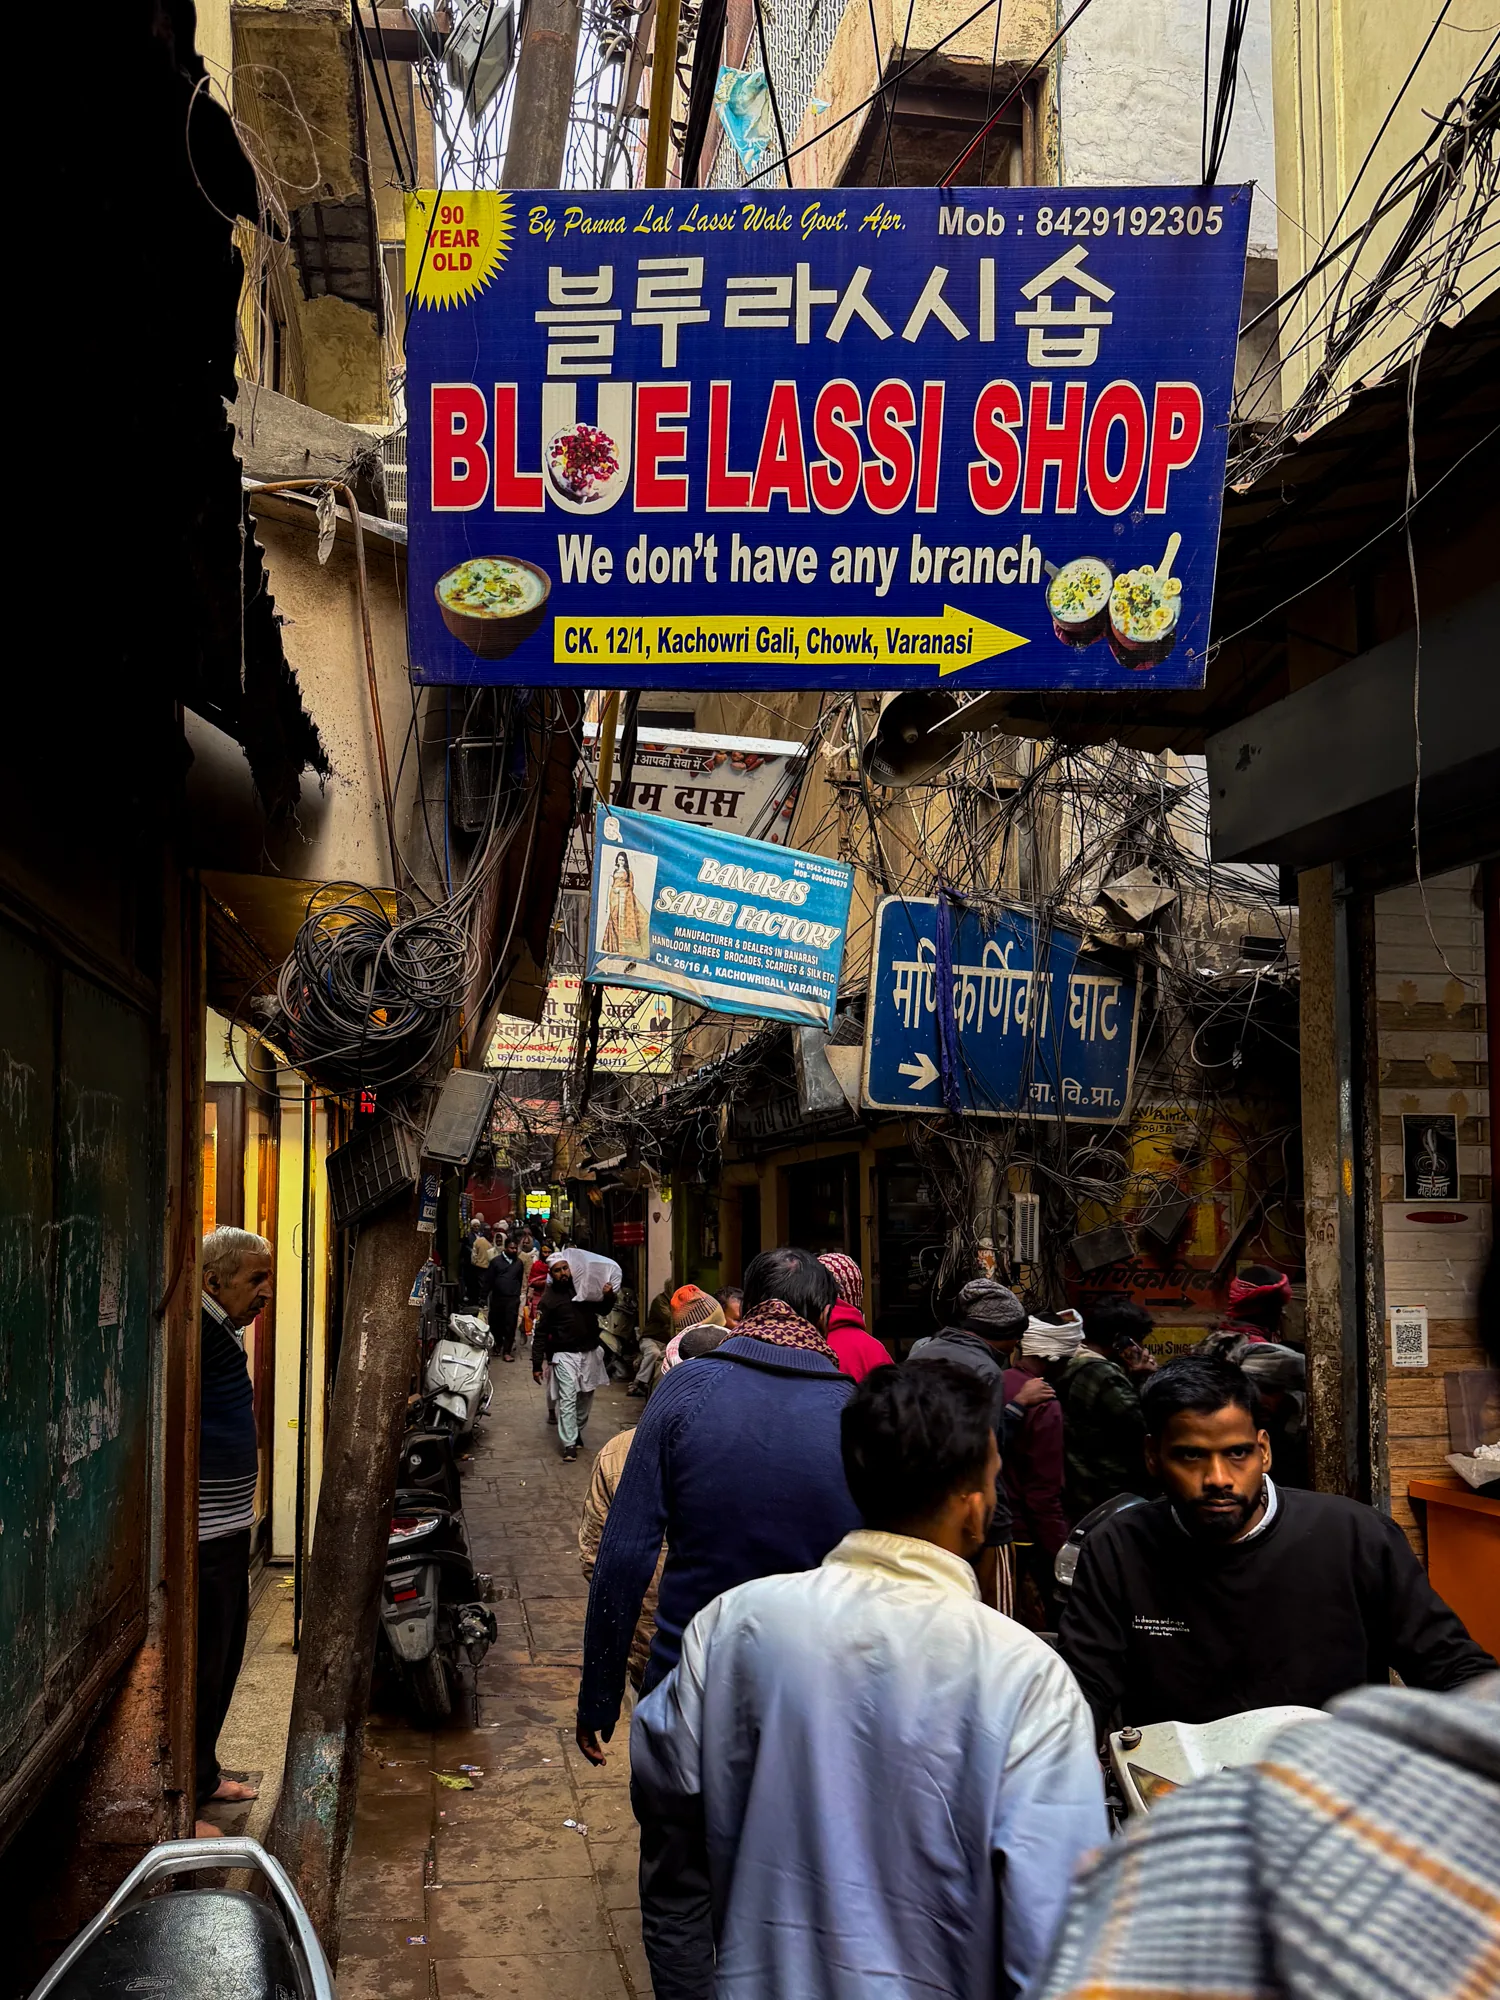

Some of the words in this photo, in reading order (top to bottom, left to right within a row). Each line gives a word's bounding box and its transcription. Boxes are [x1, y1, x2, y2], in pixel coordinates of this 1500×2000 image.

[440, 205, 464, 225] 90
[528, 205, 556, 242] By
[563, 206, 627, 238] Panna
[633, 204, 675, 235] Lal
[677, 203, 736, 233] Lassi
[741, 203, 793, 232] Wale
[800, 201, 849, 241] Govt.
[858, 202, 907, 239] Apr.
[938, 206, 1006, 236] Mob
[1035, 206, 1224, 237] 8429192305
[426, 229, 480, 249] YEAR
[432, 252, 473, 272] OLD
[431, 381, 692, 515] BLUE
[706, 379, 946, 515] LASSI
[968, 379, 1204, 516] SHOP
[557, 533, 614, 584] We
[625, 532, 718, 584] don't
[730, 533, 818, 584] have
[829, 545, 899, 598] any
[909, 533, 1042, 585] branch
[563, 626, 598, 655] CK.
[605, 626, 652, 661] 12/1,
[657, 626, 750, 655] Kachowri
[755, 626, 801, 660] Gali,
[806, 626, 880, 661] Chowk,
[886, 627, 974, 655] Varanasi
[640, 753, 671, 767] आपकी
[673, 756, 691, 769] सेवा
[673, 785, 746, 819] दास
[697, 857, 811, 907] BANARAS
[654, 885, 739, 927] SAREE
[735, 904, 842, 950] FACTORY
[652, 934, 692, 953] HANDLOOM
[692, 942, 721, 959] SAREES
[724, 951, 764, 969] BROCADES,
[798, 965, 805, 975] &
[806, 967, 822, 980] SILK
[822, 971, 837, 984] ETC.
[674, 926, 733, 947] MANUFACTURER
[734, 939, 740, 949] &
[742, 941, 773, 956] DEALERS
[775, 947, 783, 958] IN
[783, 949, 819, 965] BANARASI
[655, 952, 672, 967] C.K.
[673, 956, 700, 973] 26/16
[702, 963, 712, 977] A,
[714, 967, 787, 991] KACHOWRIGALI,
[788, 981, 832, 1001] VARANASI
[1068, 973, 1123, 1042] घाट
